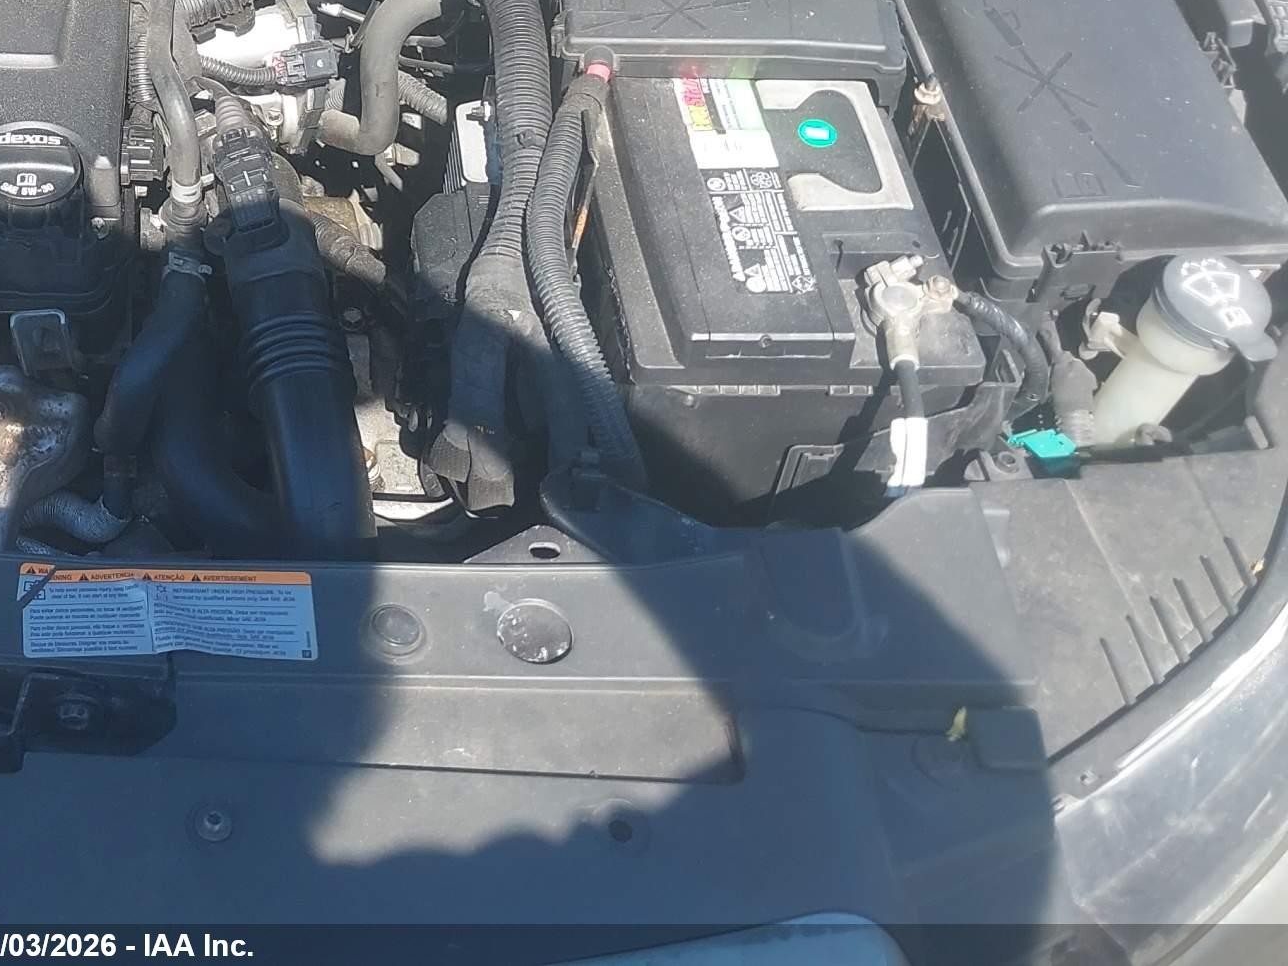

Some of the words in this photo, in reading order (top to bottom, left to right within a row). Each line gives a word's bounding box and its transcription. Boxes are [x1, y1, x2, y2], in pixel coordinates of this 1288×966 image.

[0, 181, 20, 196] SAE
[20, 181, 56, 197] 5W-30
[154, 573, 185, 582] ATENÇÃO
